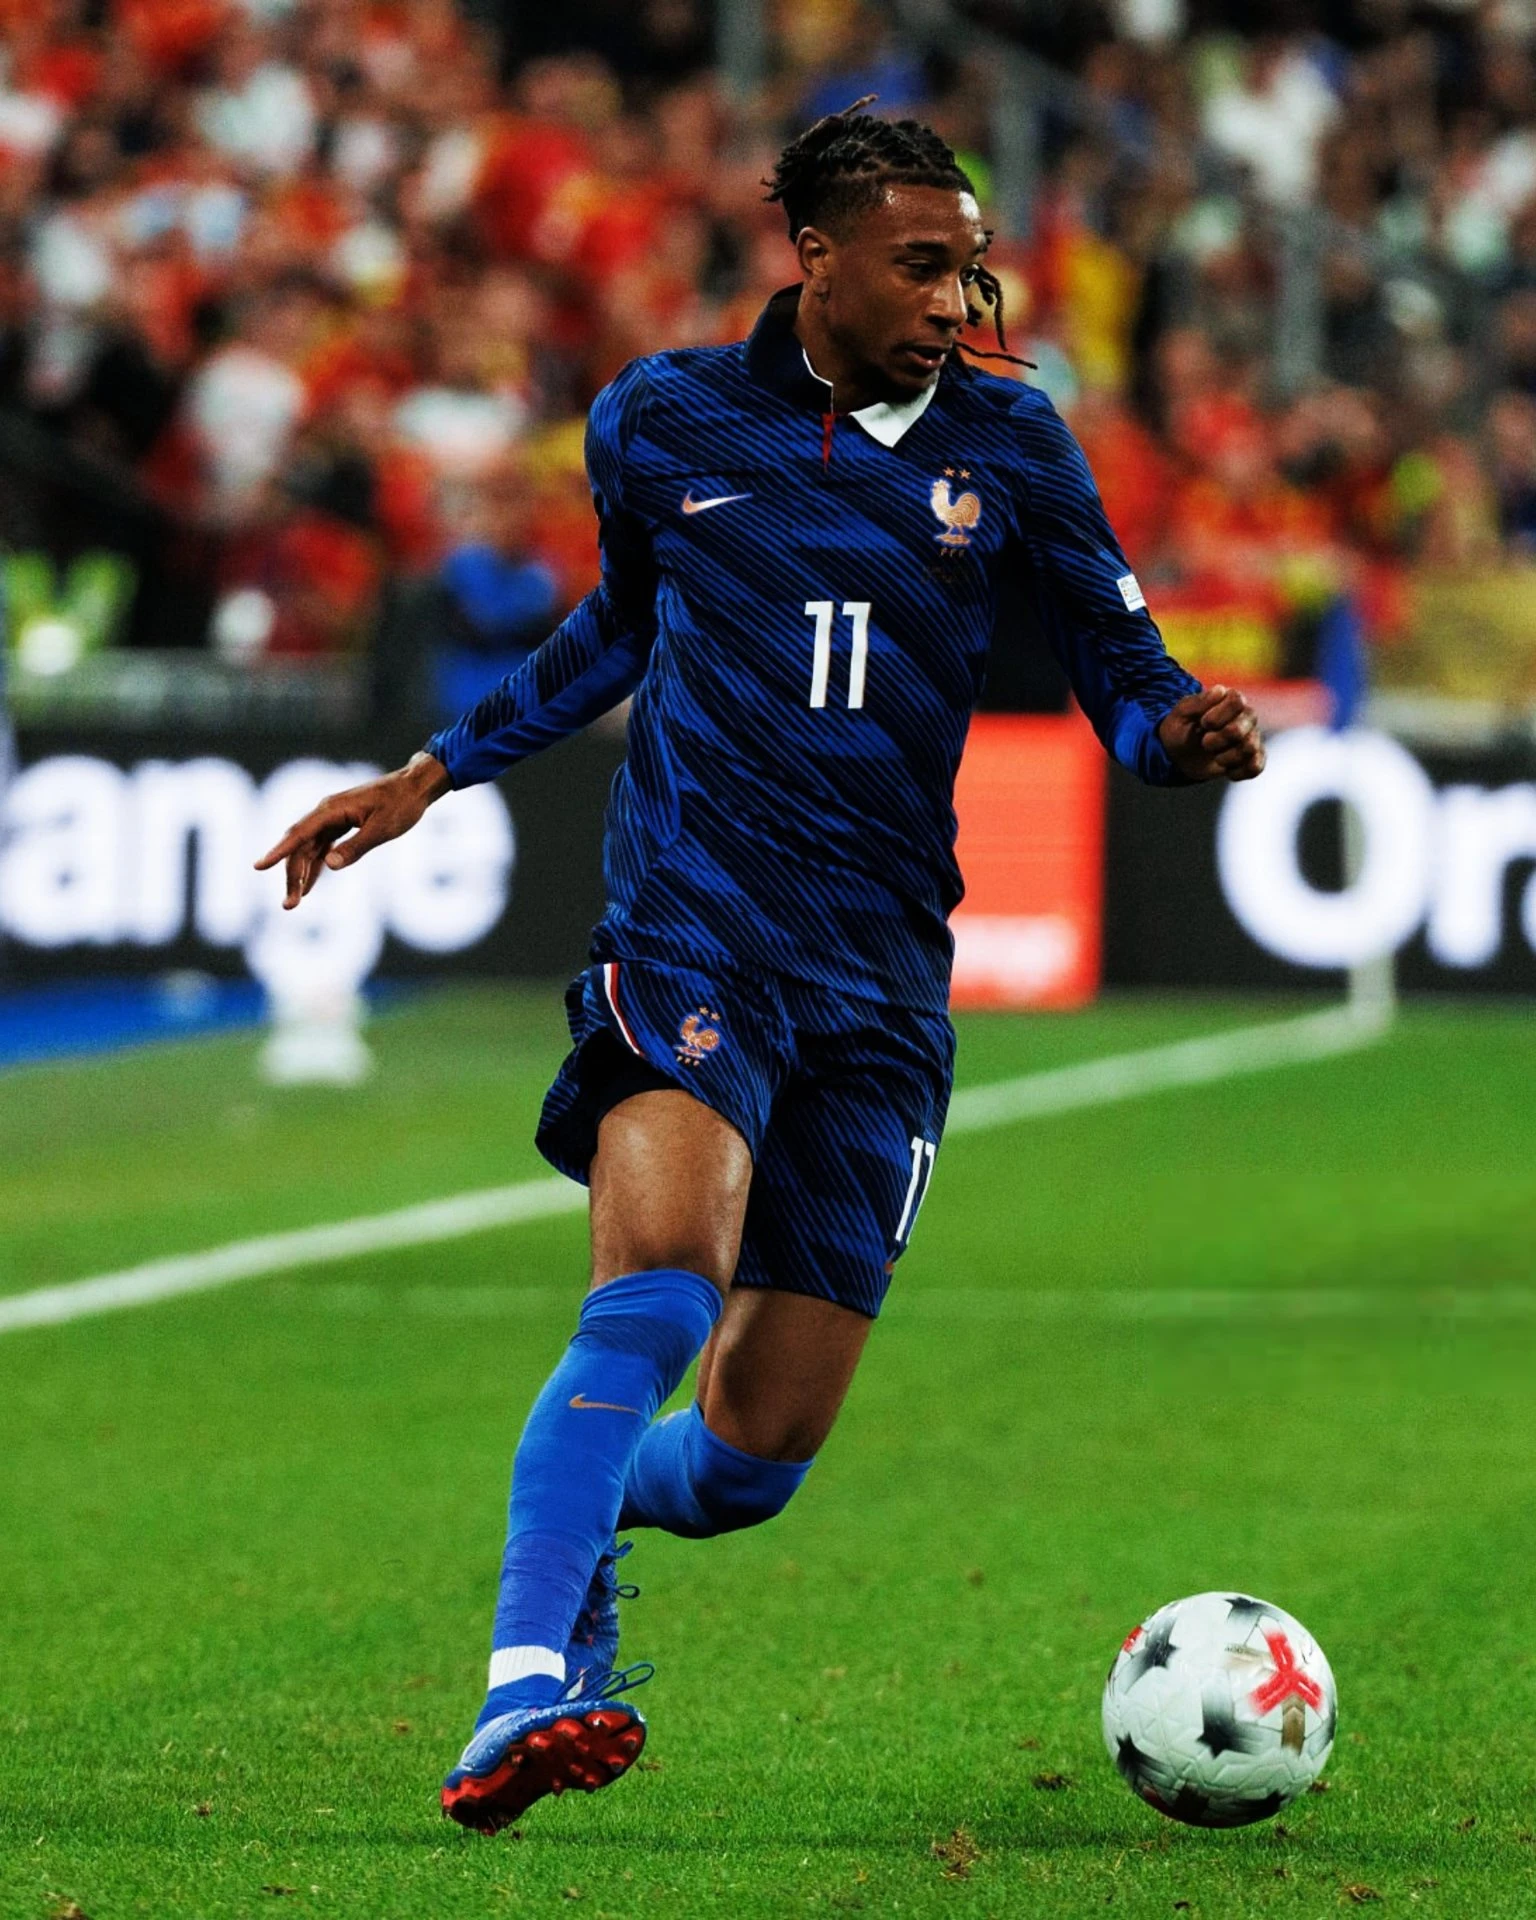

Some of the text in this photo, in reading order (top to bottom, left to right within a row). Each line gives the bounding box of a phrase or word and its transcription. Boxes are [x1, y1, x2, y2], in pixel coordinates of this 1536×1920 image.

[804, 600, 871, 709] 11
[1216, 726, 1536, 968] Or
[895, 1136, 936, 1246] 11
